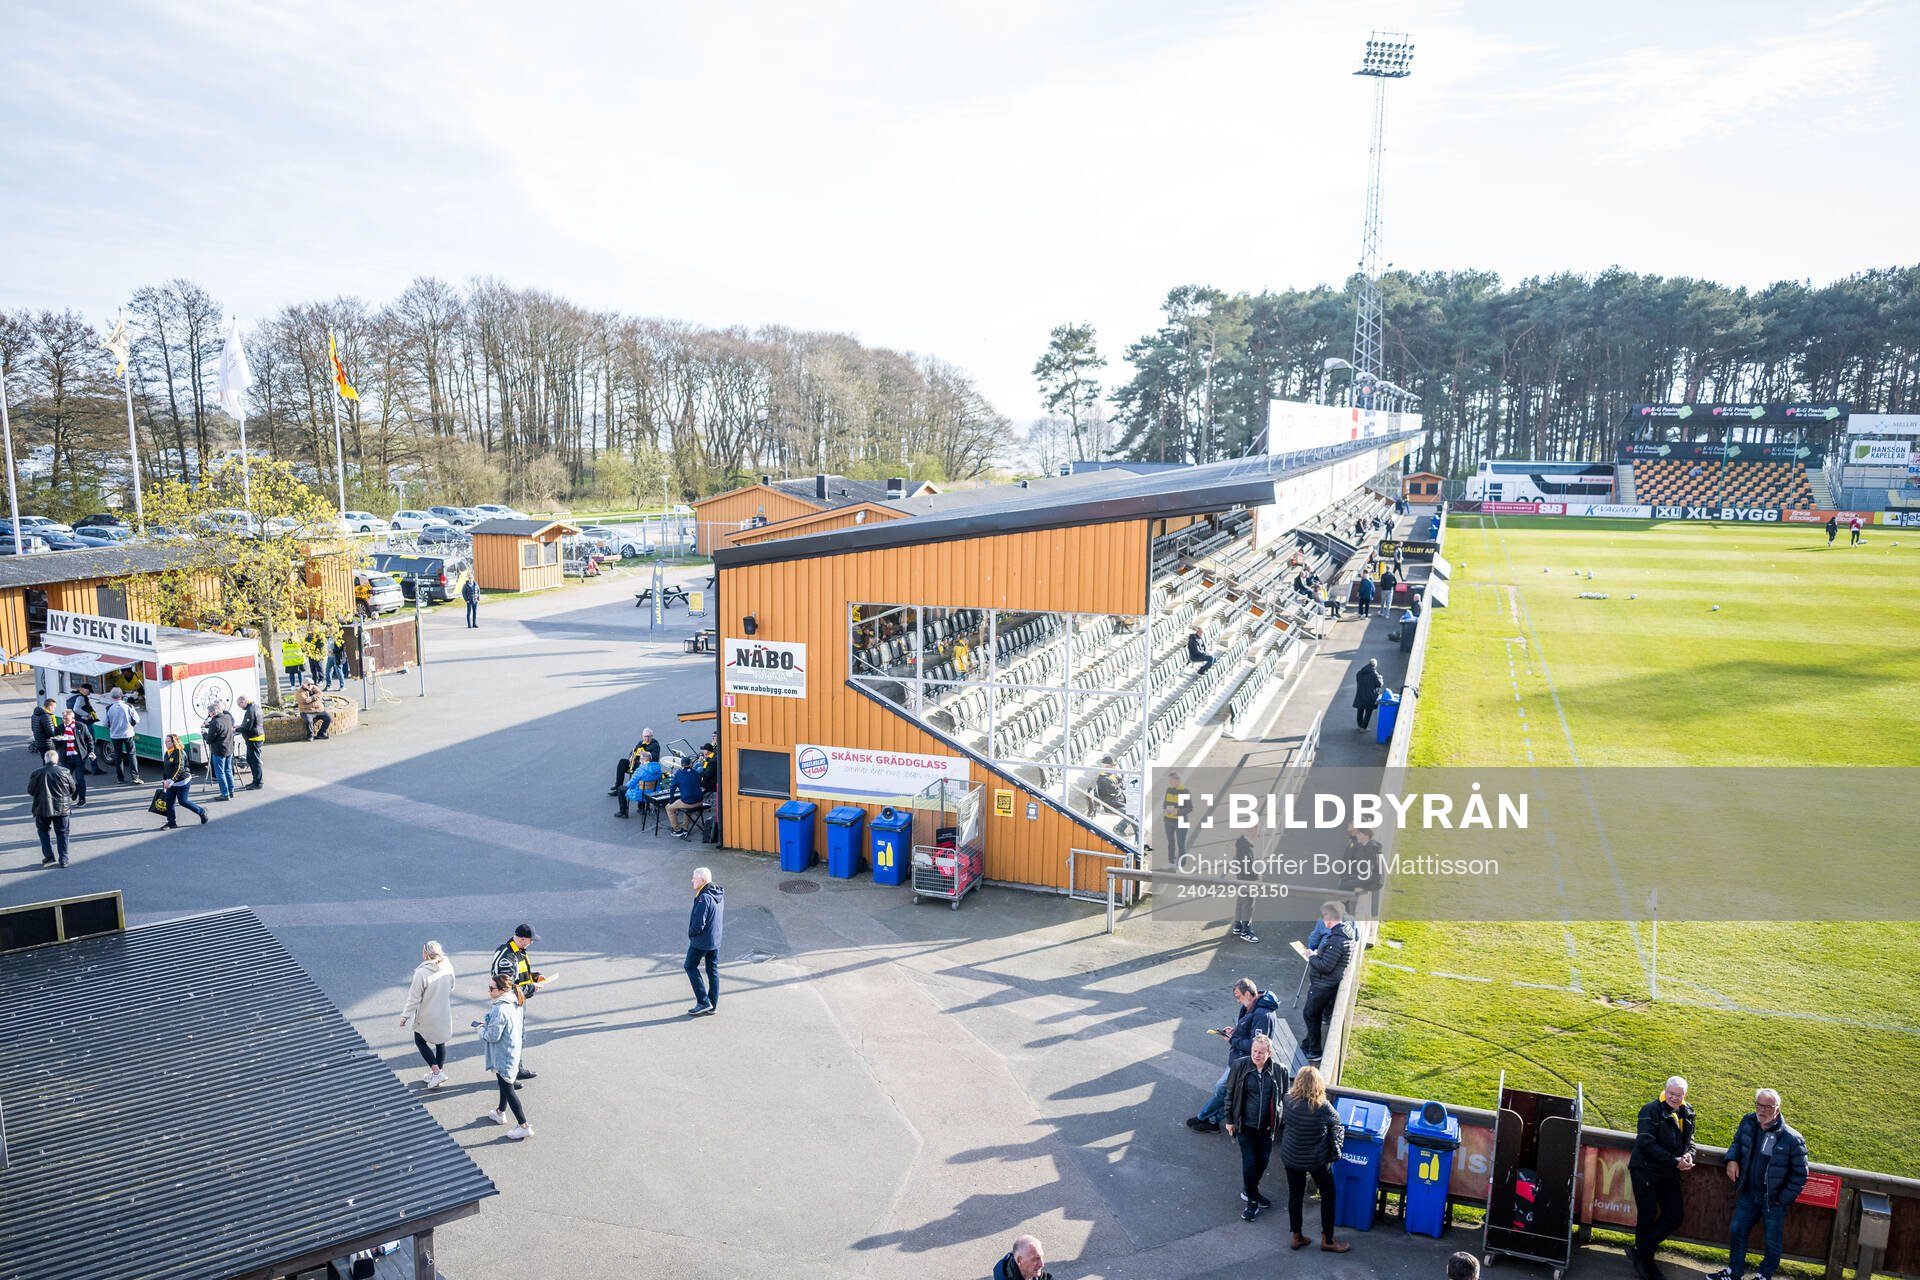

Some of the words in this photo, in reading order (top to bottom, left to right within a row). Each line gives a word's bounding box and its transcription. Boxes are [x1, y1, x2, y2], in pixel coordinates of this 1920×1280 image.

[1686, 507, 1778, 522] XL-BYGG
[50, 614, 69, 632] NY
[73, 617, 117, 640] STEKT
[121, 624, 153, 646] SILL
[736, 644, 794, 671] NÄBO
[733, 684, 798, 695] www.nabobygg.com
[831, 750, 873, 764] SKÅNSK
[875, 755, 948, 770] GRÄDDGLASS
